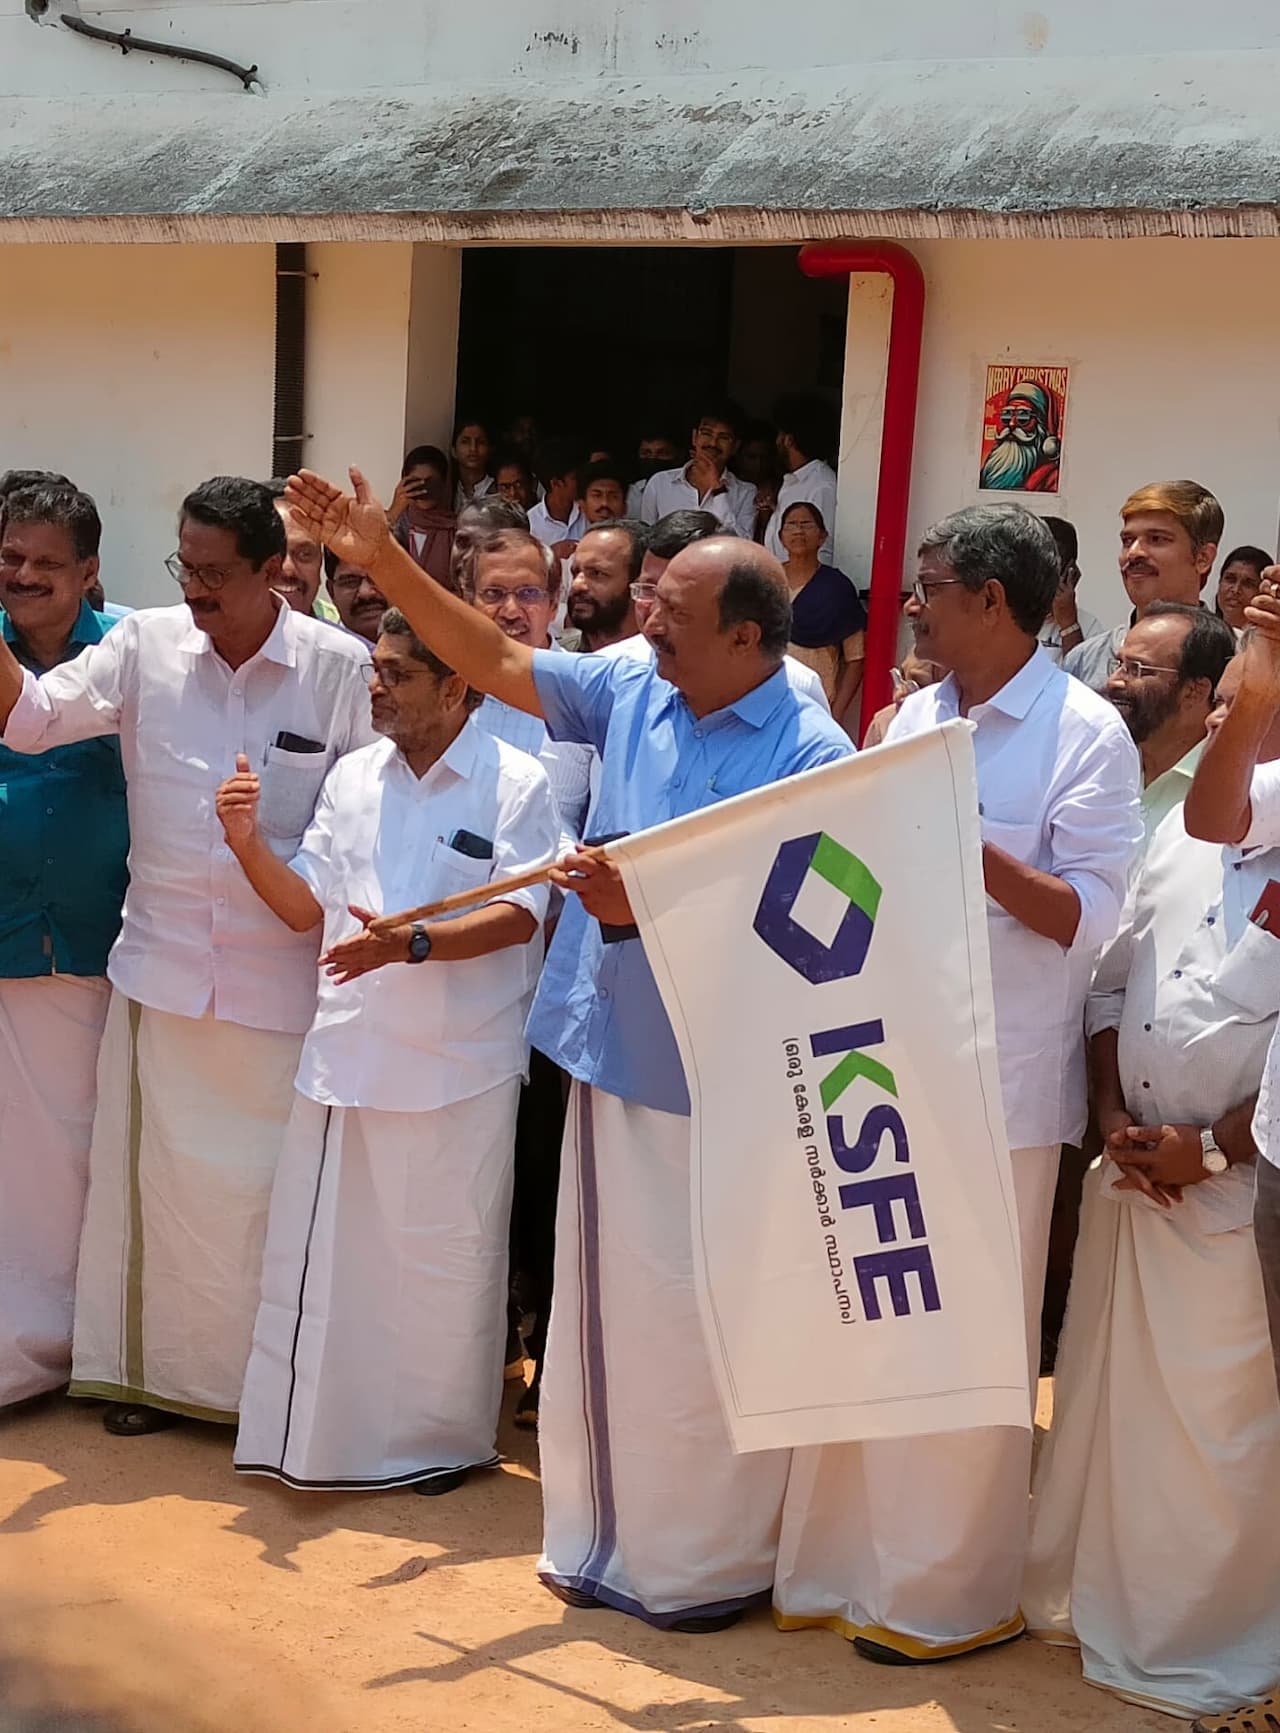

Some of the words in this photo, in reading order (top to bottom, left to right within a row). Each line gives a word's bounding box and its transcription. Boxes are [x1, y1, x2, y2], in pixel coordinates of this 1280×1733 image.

[1017, 368, 1067, 398] CHRISTMAS
[793, 1083, 815, 1139] കേരള
[809, 1018, 942, 1322] KSFE
